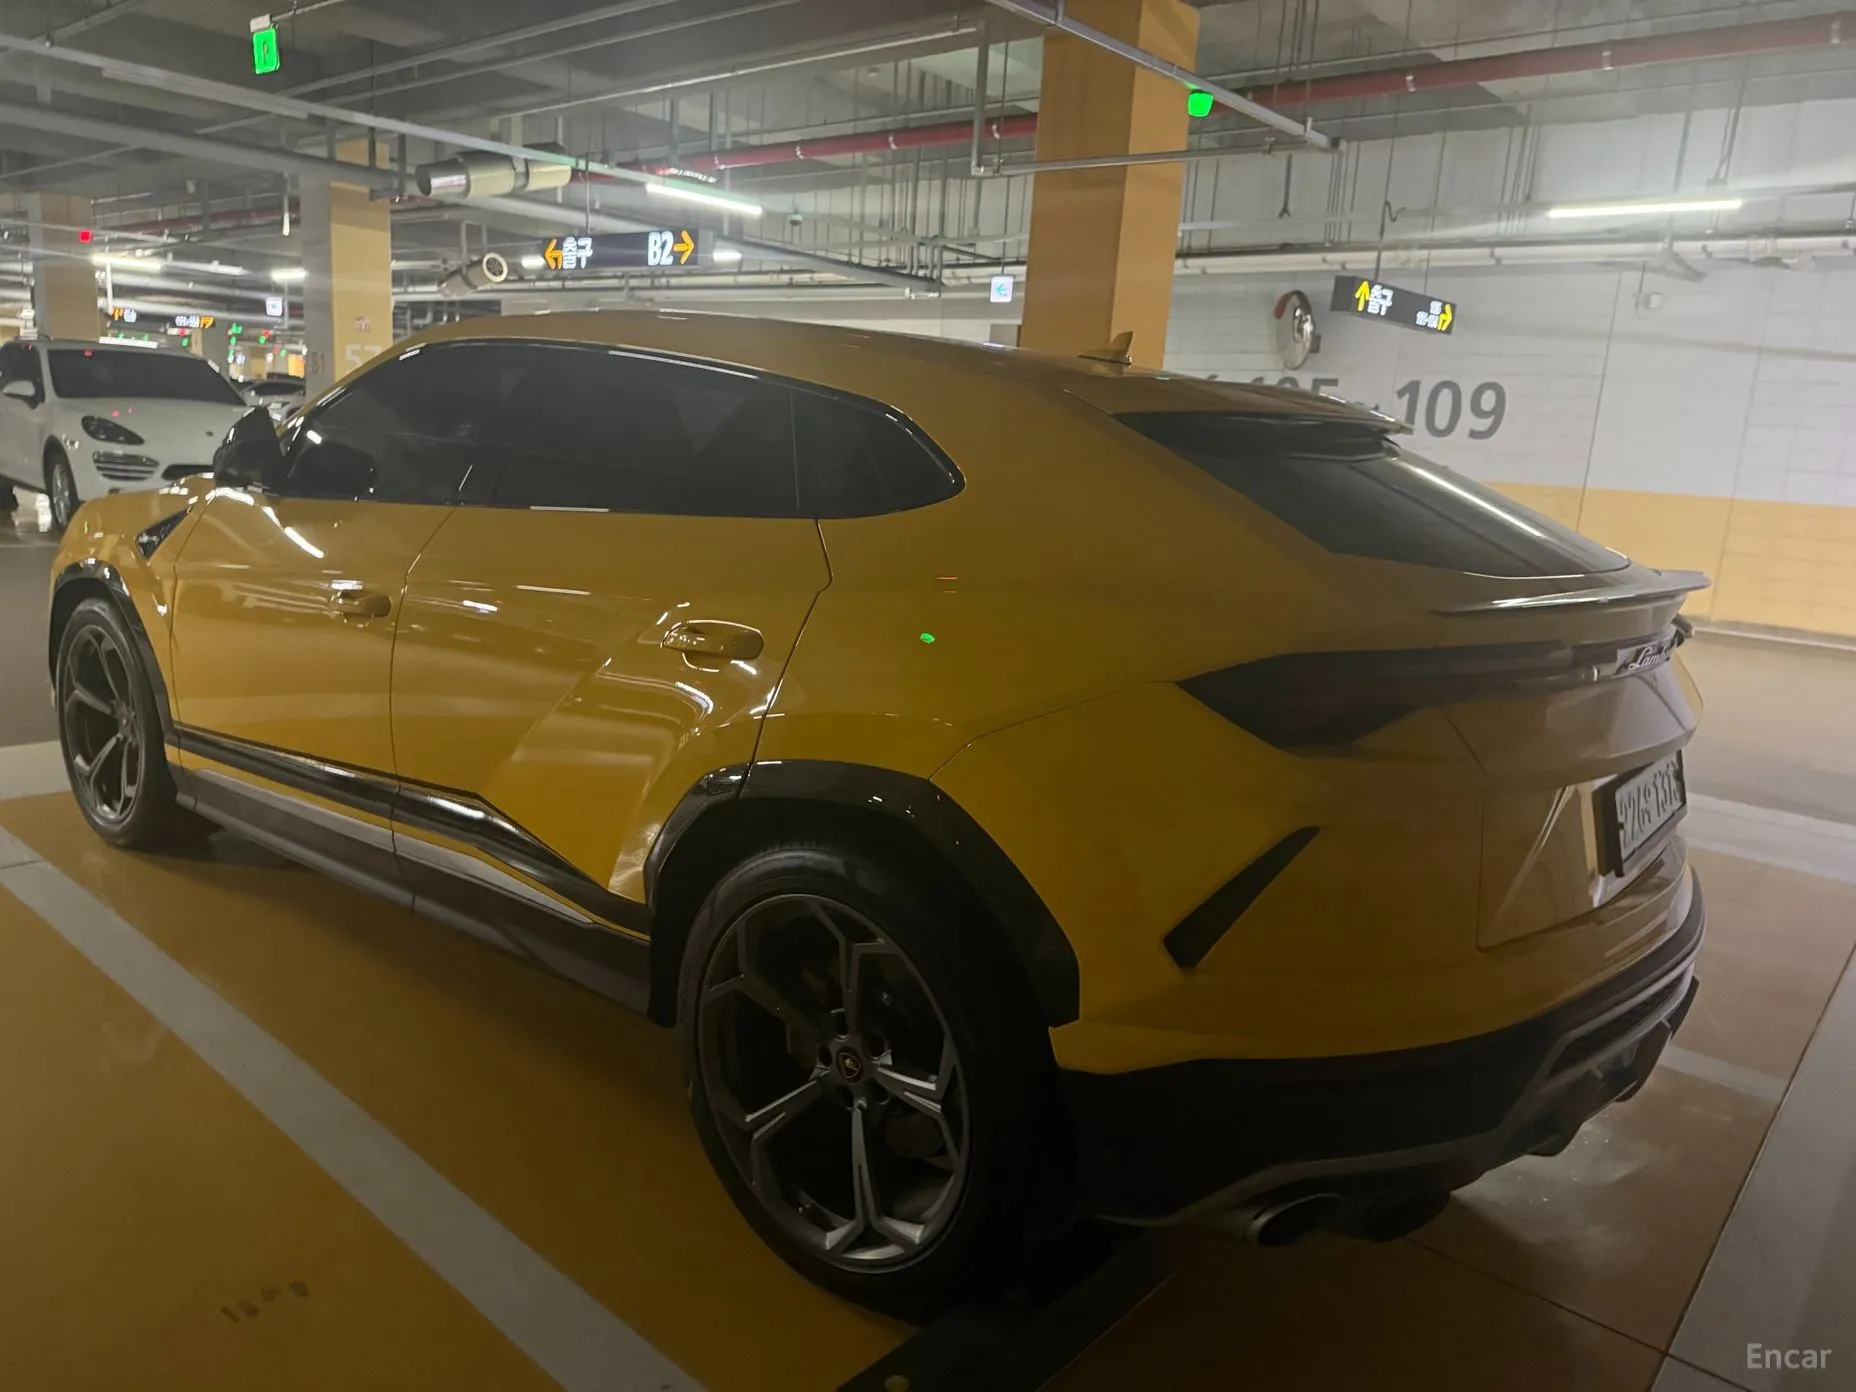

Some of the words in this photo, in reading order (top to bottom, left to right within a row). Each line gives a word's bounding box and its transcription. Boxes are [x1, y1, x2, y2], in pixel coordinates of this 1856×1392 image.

[562, 236, 593, 269] 출구
[647, 230, 674, 266] B2
[1367, 284, 1394, 316] 출구
[1396, 379, 1506, 441] 109
